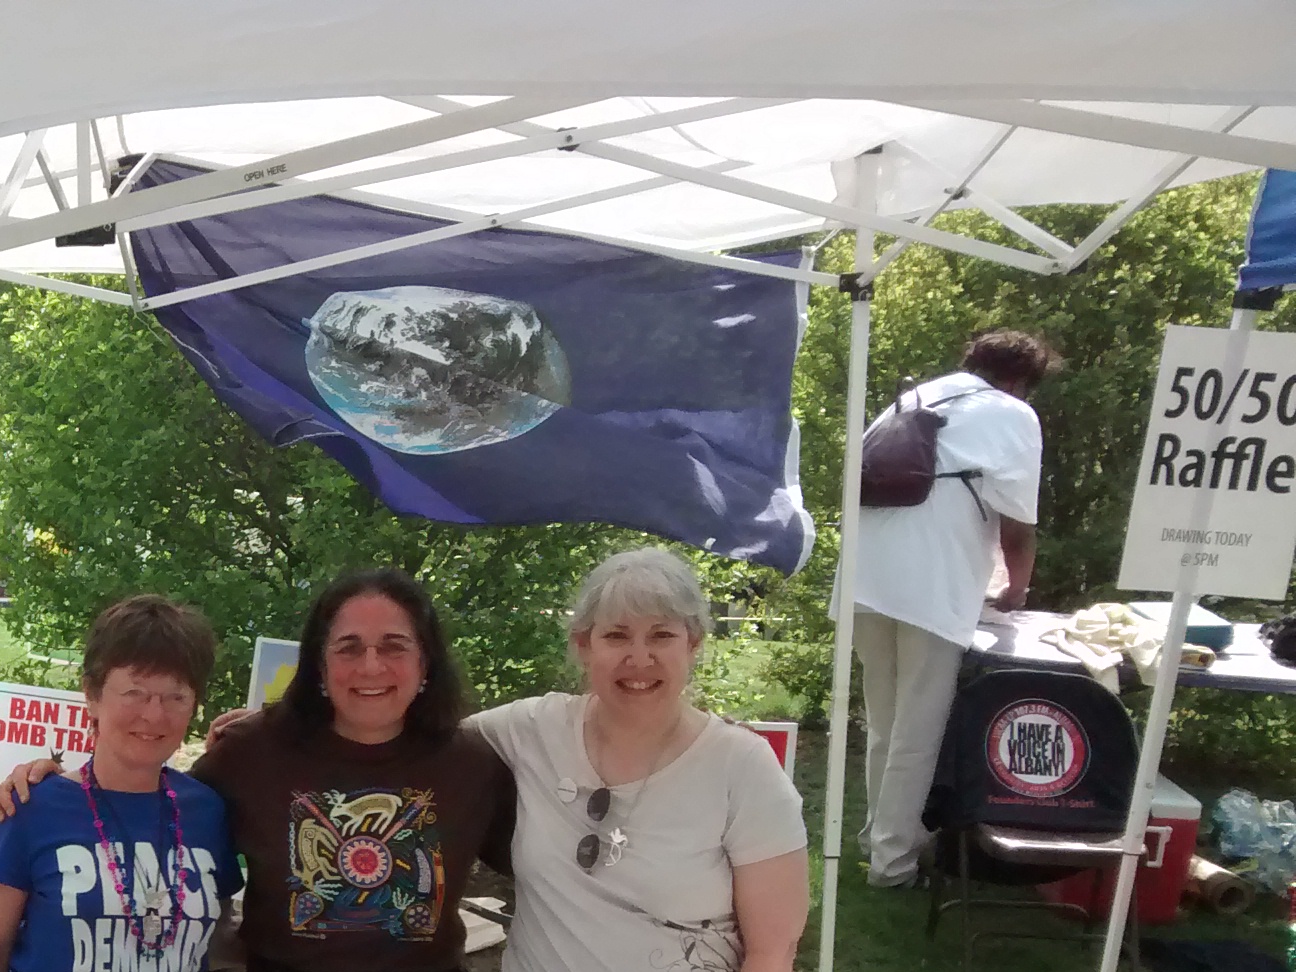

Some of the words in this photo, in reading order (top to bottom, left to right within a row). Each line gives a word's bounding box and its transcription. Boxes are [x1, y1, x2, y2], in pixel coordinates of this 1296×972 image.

[244, 170, 264, 182] OPEN
[266, 163, 287, 176] HERE
[1163, 366, 1296, 426] 50/50
[1149, 433, 1296, 494] Raffle
[1161, 528, 1213, 546] DRAWING
[1214, 531, 1252, 547] TODAY
[1192, 553, 1219, 567] 5PM
[9, 697, 60, 725] BAN
[66, 705, 92, 729] TH
[53, 727, 96, 753] TRA
[1017, 722, 1052, 742] HAVE
[1054, 725, 1065, 743] A
[1008, 740, 1049, 760] VOICE
[1052, 742, 1066, 760] IN
